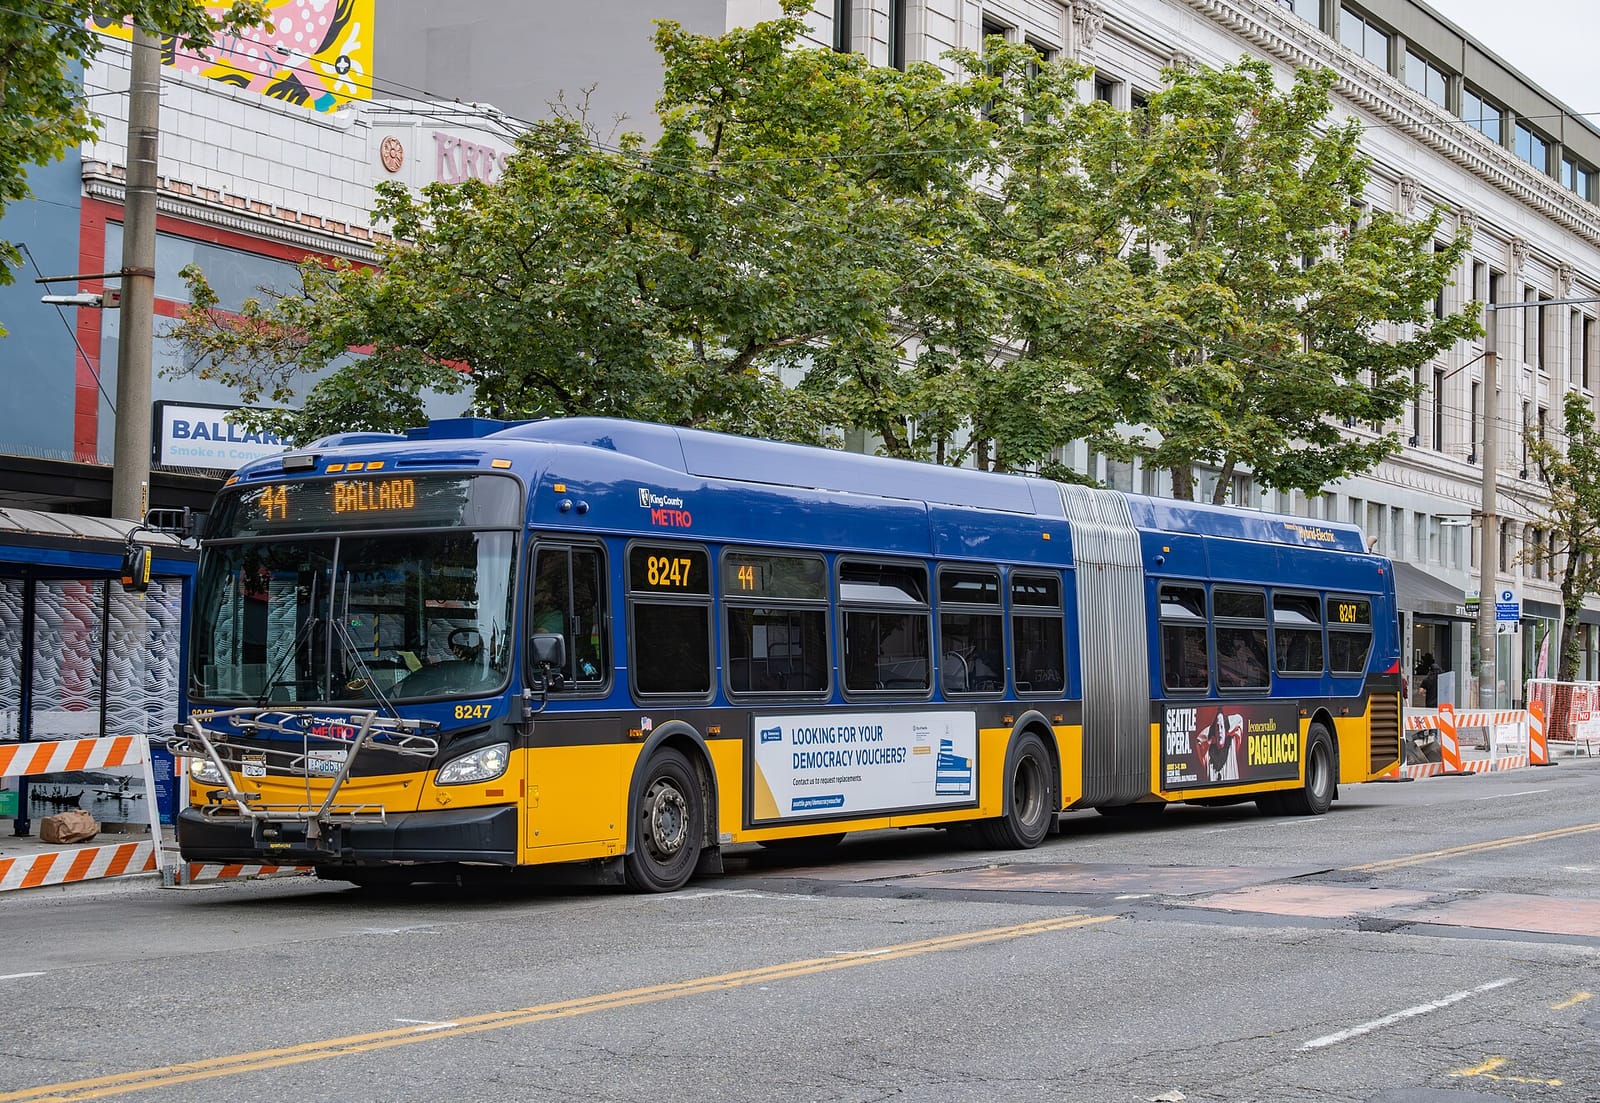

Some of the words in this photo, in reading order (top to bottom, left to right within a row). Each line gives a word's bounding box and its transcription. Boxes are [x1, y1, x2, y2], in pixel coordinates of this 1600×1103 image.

[170, 445, 213, 458] Smoke
[259, 484, 288, 520] 44
[334, 479, 416, 512] BALLARD
[650, 494, 664, 507] King
[663, 495, 684, 508] County
[651, 508, 692, 528] METRO
[647, 555, 692, 587] 8247
[738, 565, 753, 590] 44
[1339, 604, 1357, 623] 8247
[454, 704, 492, 719] 8247
[1166, 708, 1197, 731] SEATTLE
[1579, 712, 1589, 720] NO
[791, 727, 836, 745] LOOKING
[838, 726, 857, 743] FOR
[858, 725, 883, 742] YOUR
[1248, 718, 1277, 732] leoncavallo
[1166, 731, 1193, 755] OPERA.
[1248, 732, 1298, 766] PAGLIACCI
[793, 750, 853, 770] DEMOCRACY
[856, 747, 907, 766] VOUCHERS?
[792, 777, 809, 786] Contact
[821, 777, 836, 785] request
